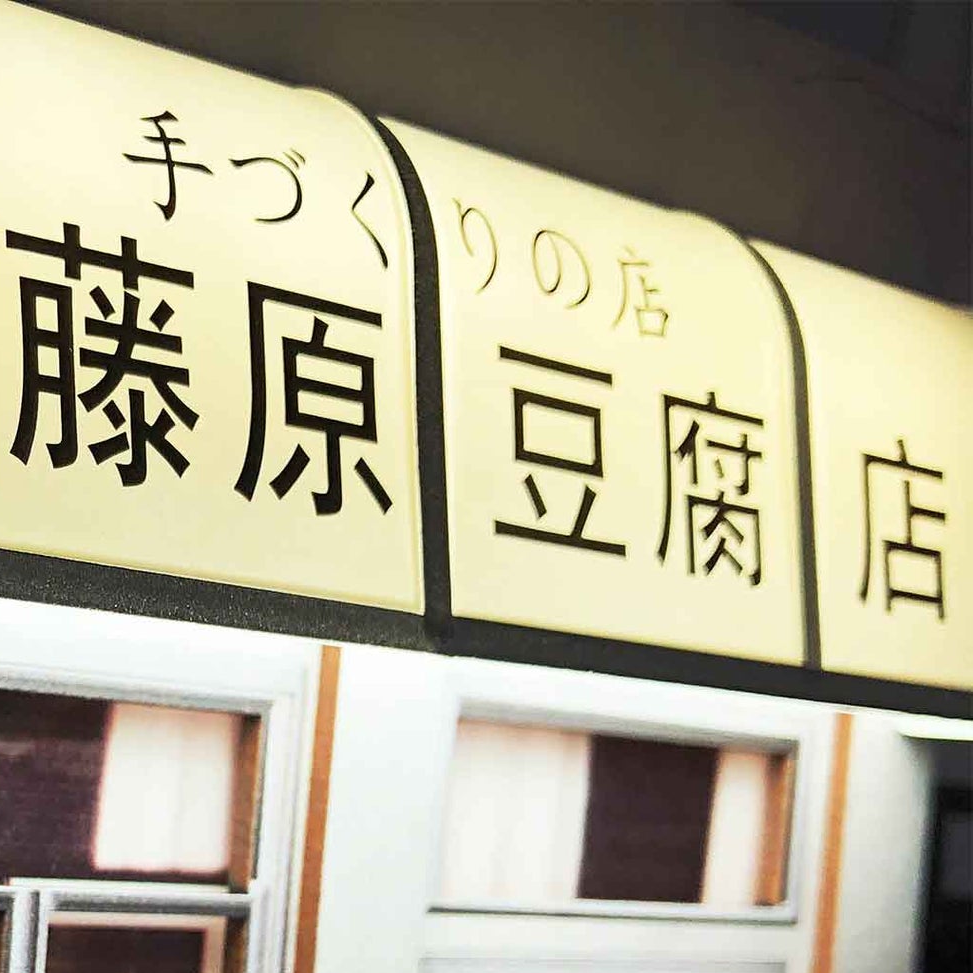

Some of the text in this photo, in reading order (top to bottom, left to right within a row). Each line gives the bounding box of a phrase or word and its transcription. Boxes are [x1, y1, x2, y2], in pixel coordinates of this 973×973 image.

[123, 110, 669, 338] 手づくりの店
[4, 221, 946, 622] 藤原豆腐店
